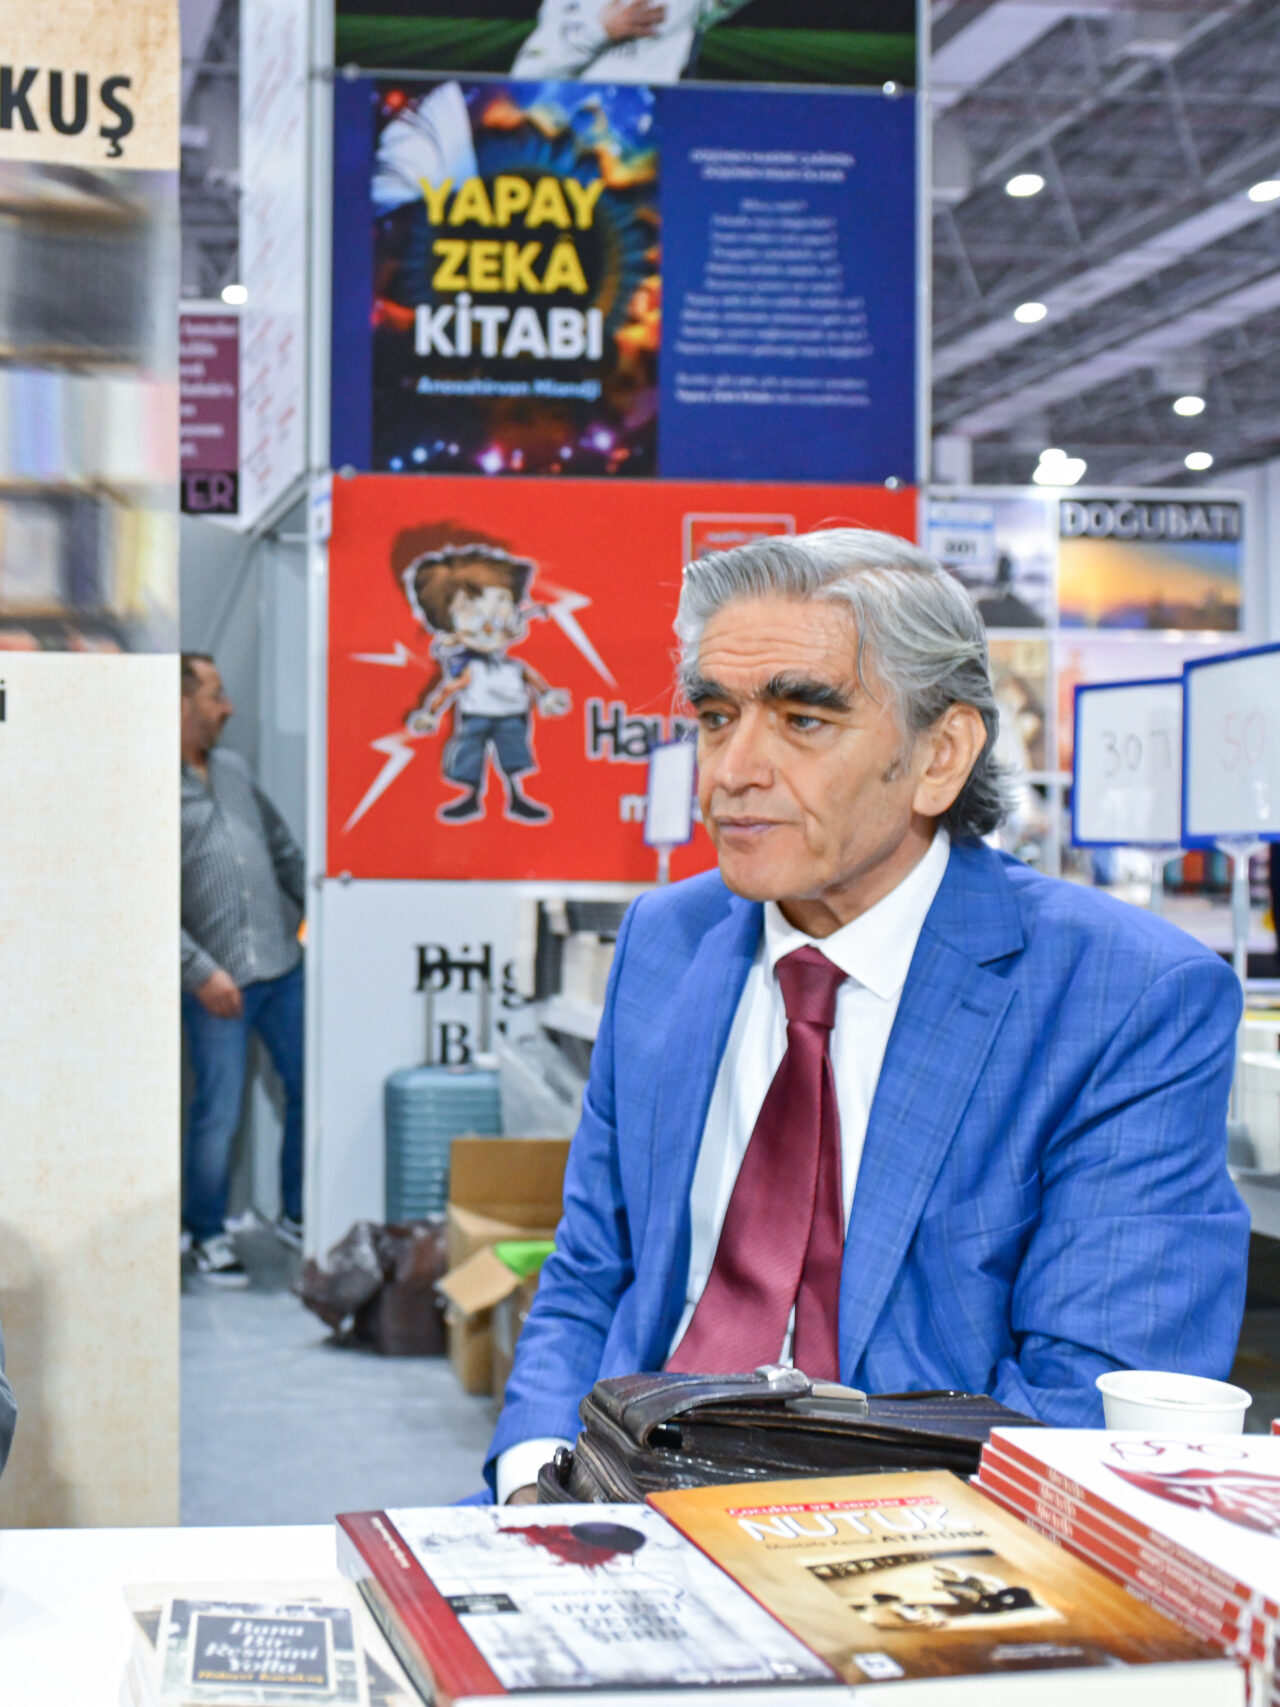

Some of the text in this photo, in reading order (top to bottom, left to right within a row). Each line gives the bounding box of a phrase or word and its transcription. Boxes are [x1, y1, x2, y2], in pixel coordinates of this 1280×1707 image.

[419, 175, 604, 229] YAPAY
[416, 292, 603, 360] KİTABI
[737, 1507, 972, 1541] NUTUK
